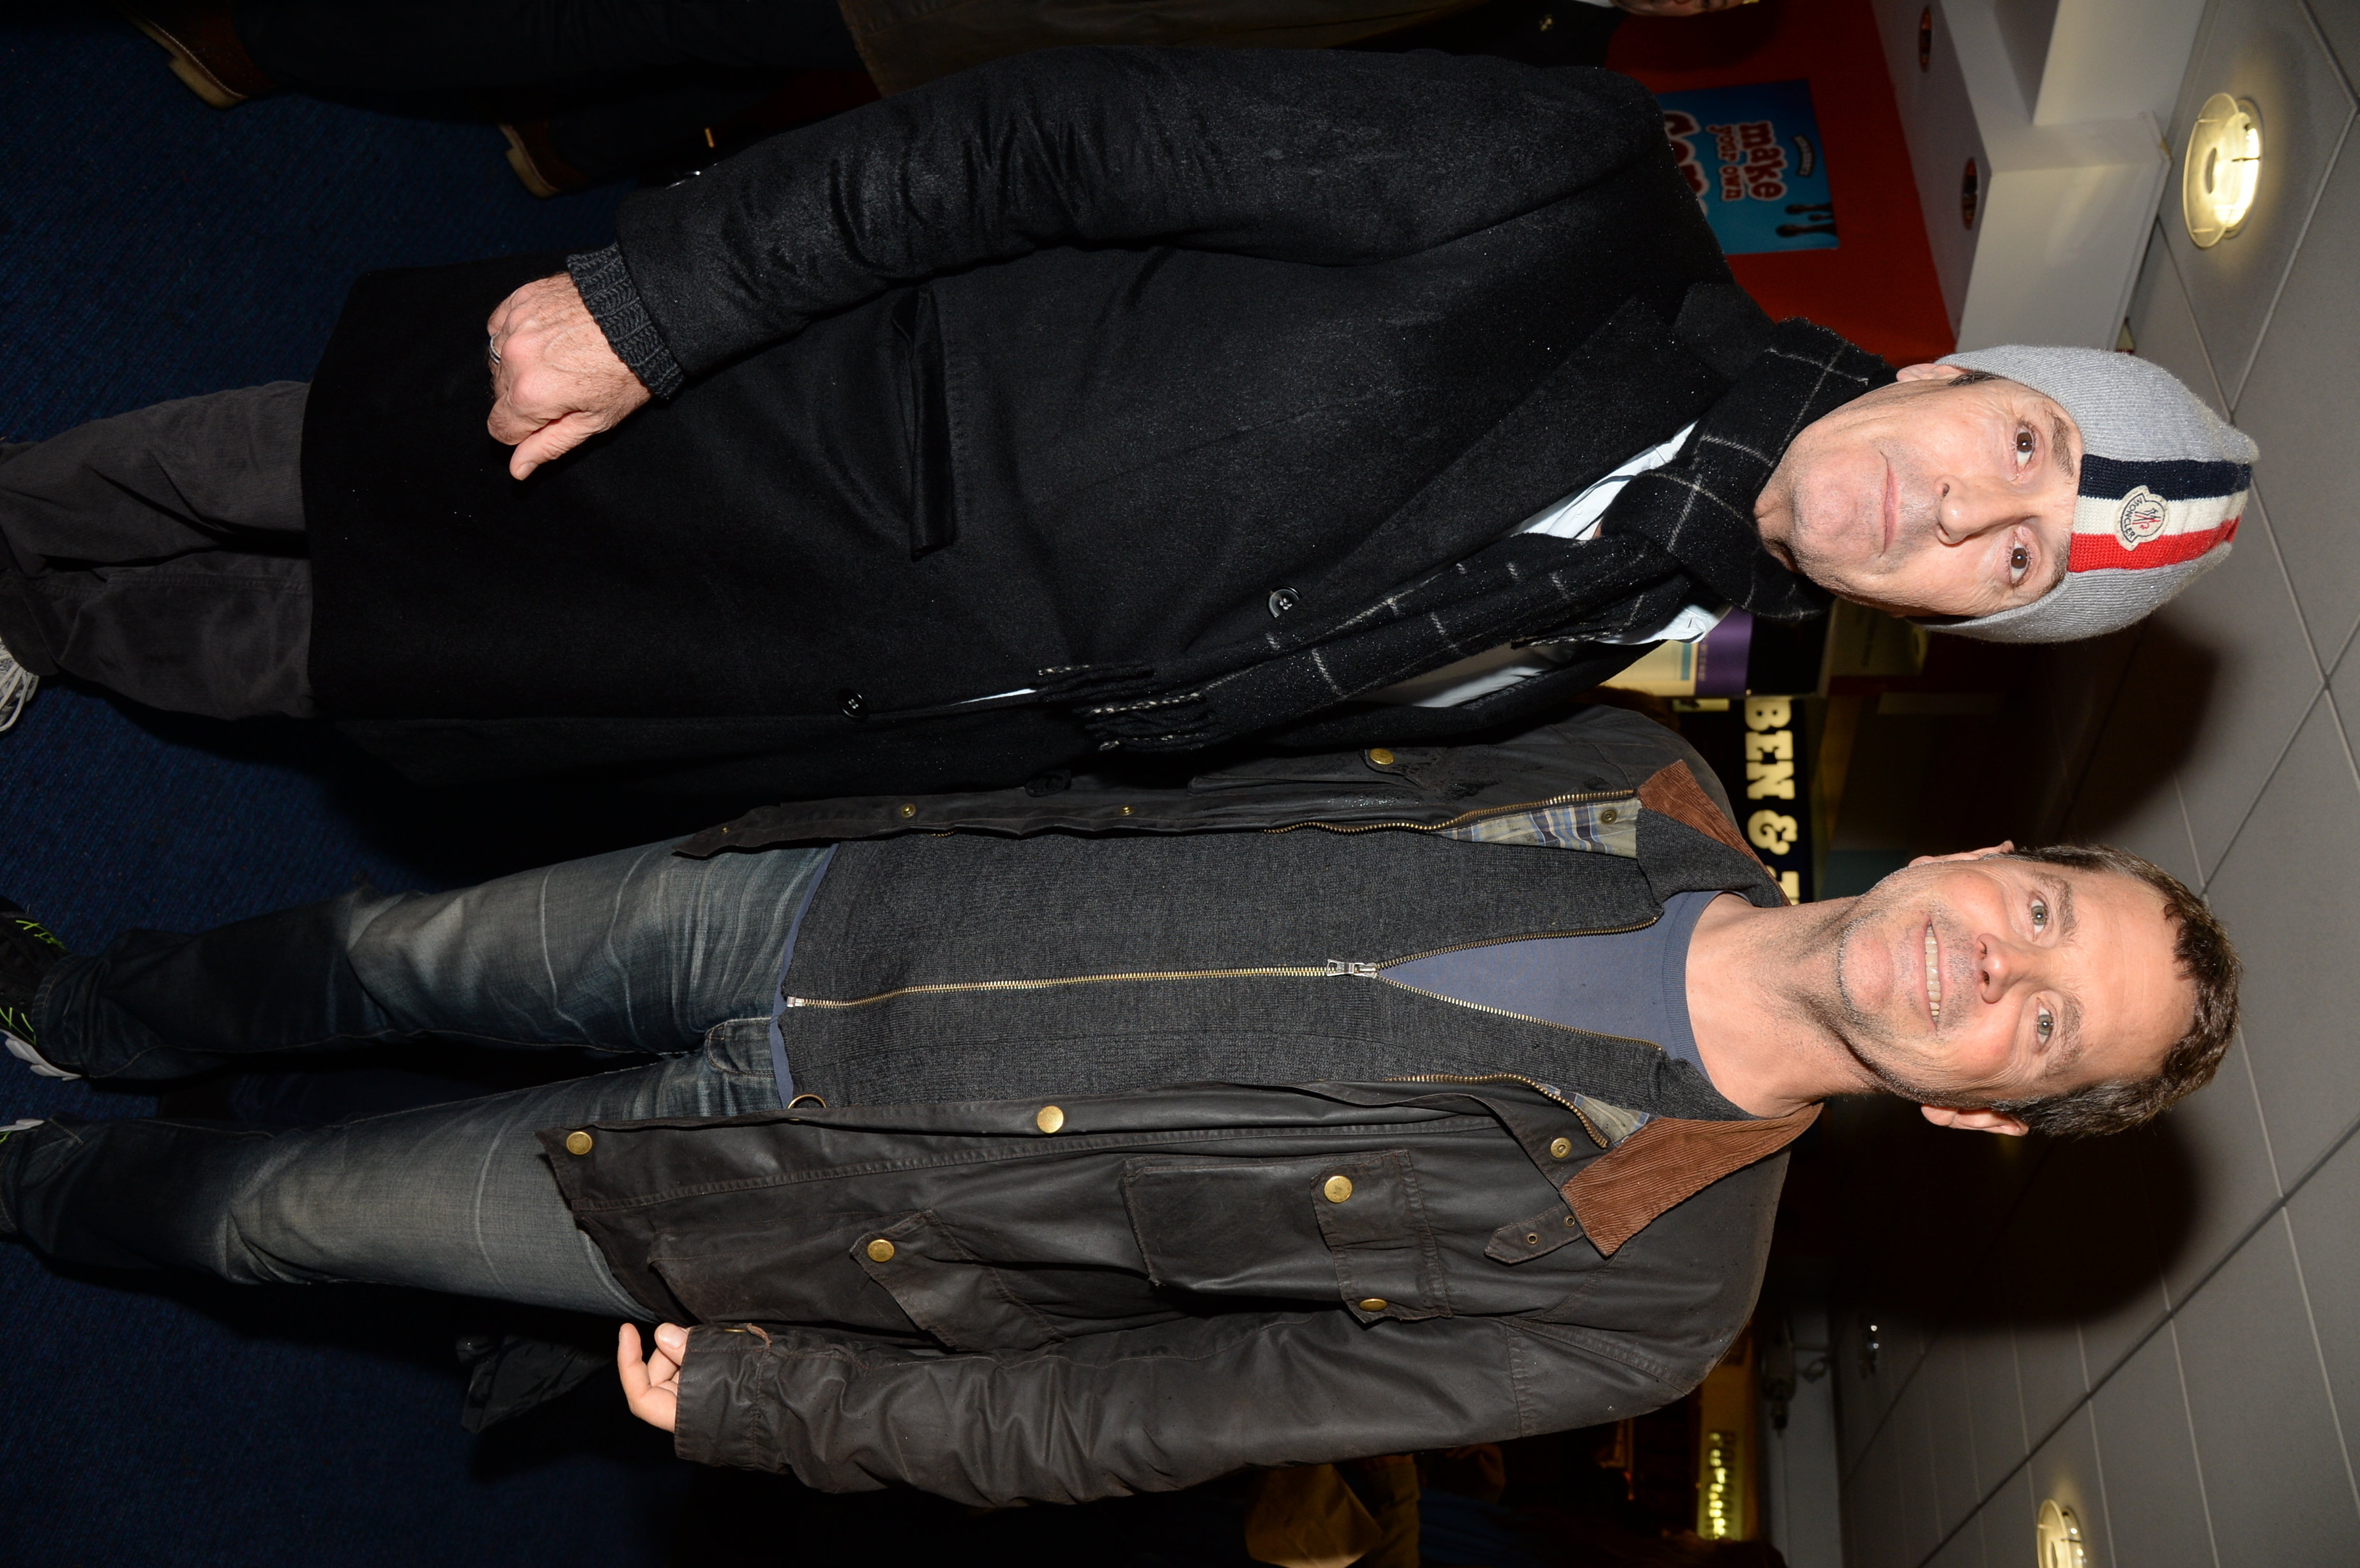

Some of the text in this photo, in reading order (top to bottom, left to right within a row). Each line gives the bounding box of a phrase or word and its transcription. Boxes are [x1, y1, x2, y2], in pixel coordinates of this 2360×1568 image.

[1707, 125, 1742, 200] your own
[1738, 122, 1785, 199] make
[2124, 497, 2143, 539] MONCLER
[1744, 700, 1796, 800] BEN
[1747, 810, 1799, 856] &
